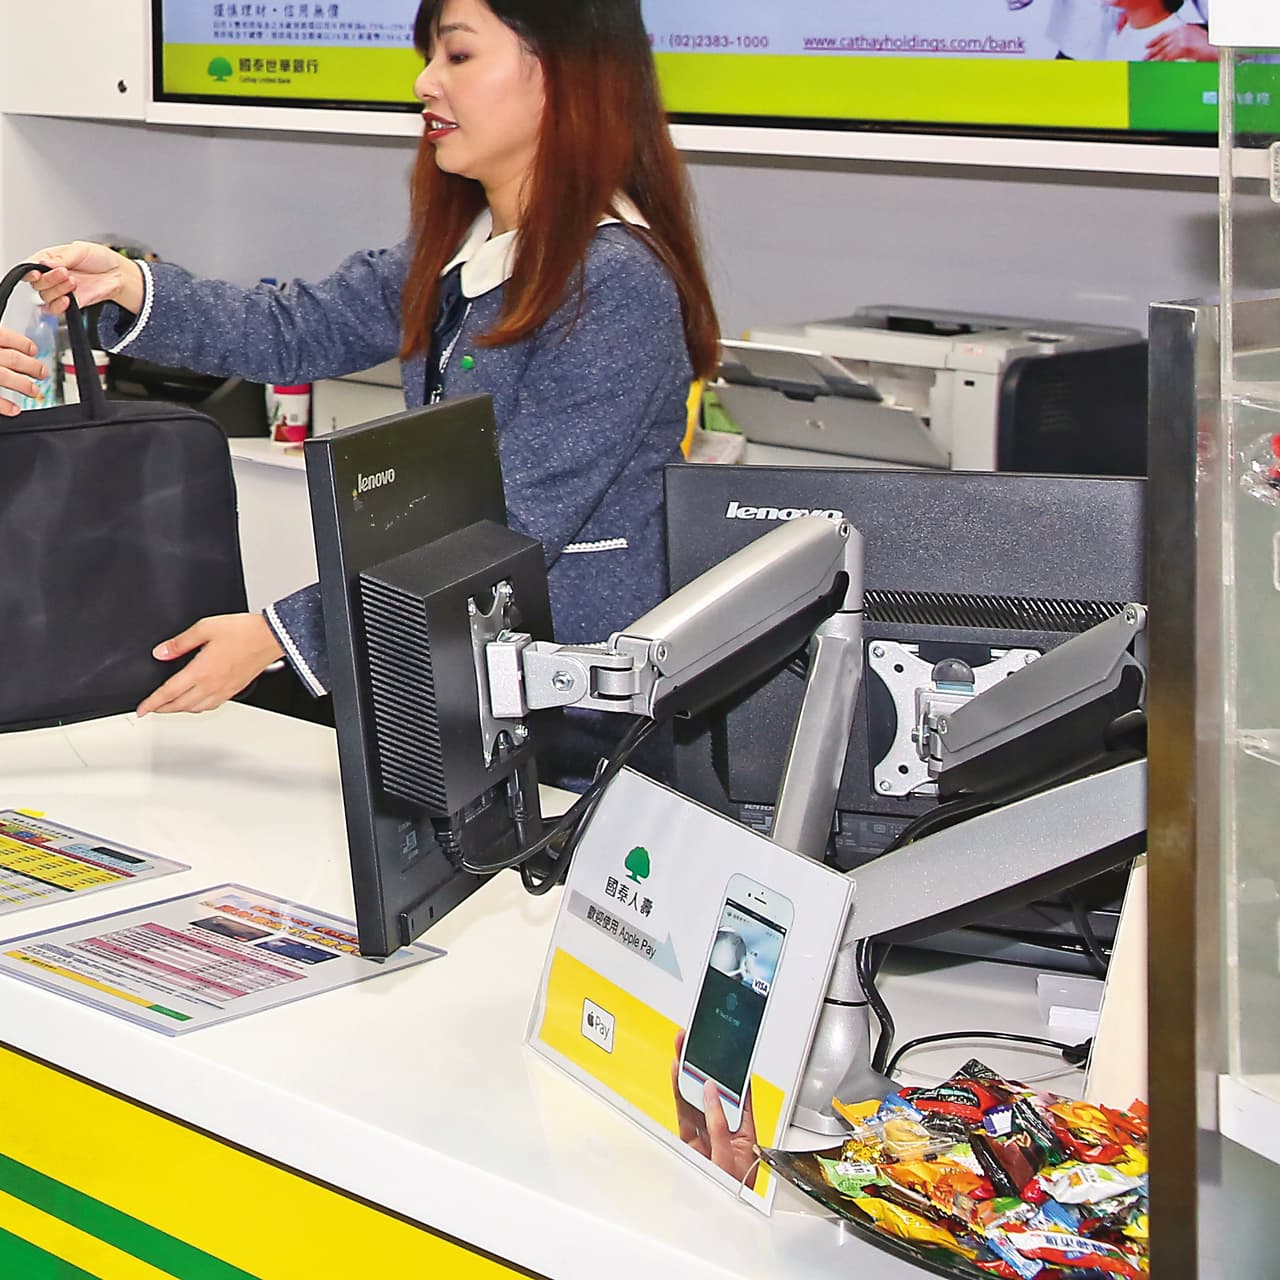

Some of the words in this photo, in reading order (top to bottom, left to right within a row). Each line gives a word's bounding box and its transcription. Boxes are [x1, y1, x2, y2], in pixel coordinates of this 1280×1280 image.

[803, 33, 1025, 53] www.cathayholdings.com/bank
[239, 57, 319, 75] 國泰世華銀行
[357, 468, 396, 493] lenovo
[725, 501, 844, 521] lenovo
[604, 876, 655, 918] 國泰人壽
[586, 904, 620, 936] 歡迎使用
[619, 924, 640, 948] Apple
[640, 938, 657, 960] Pay
[753, 978, 769, 994] VISA
[594, 1015, 611, 1041] Pay
